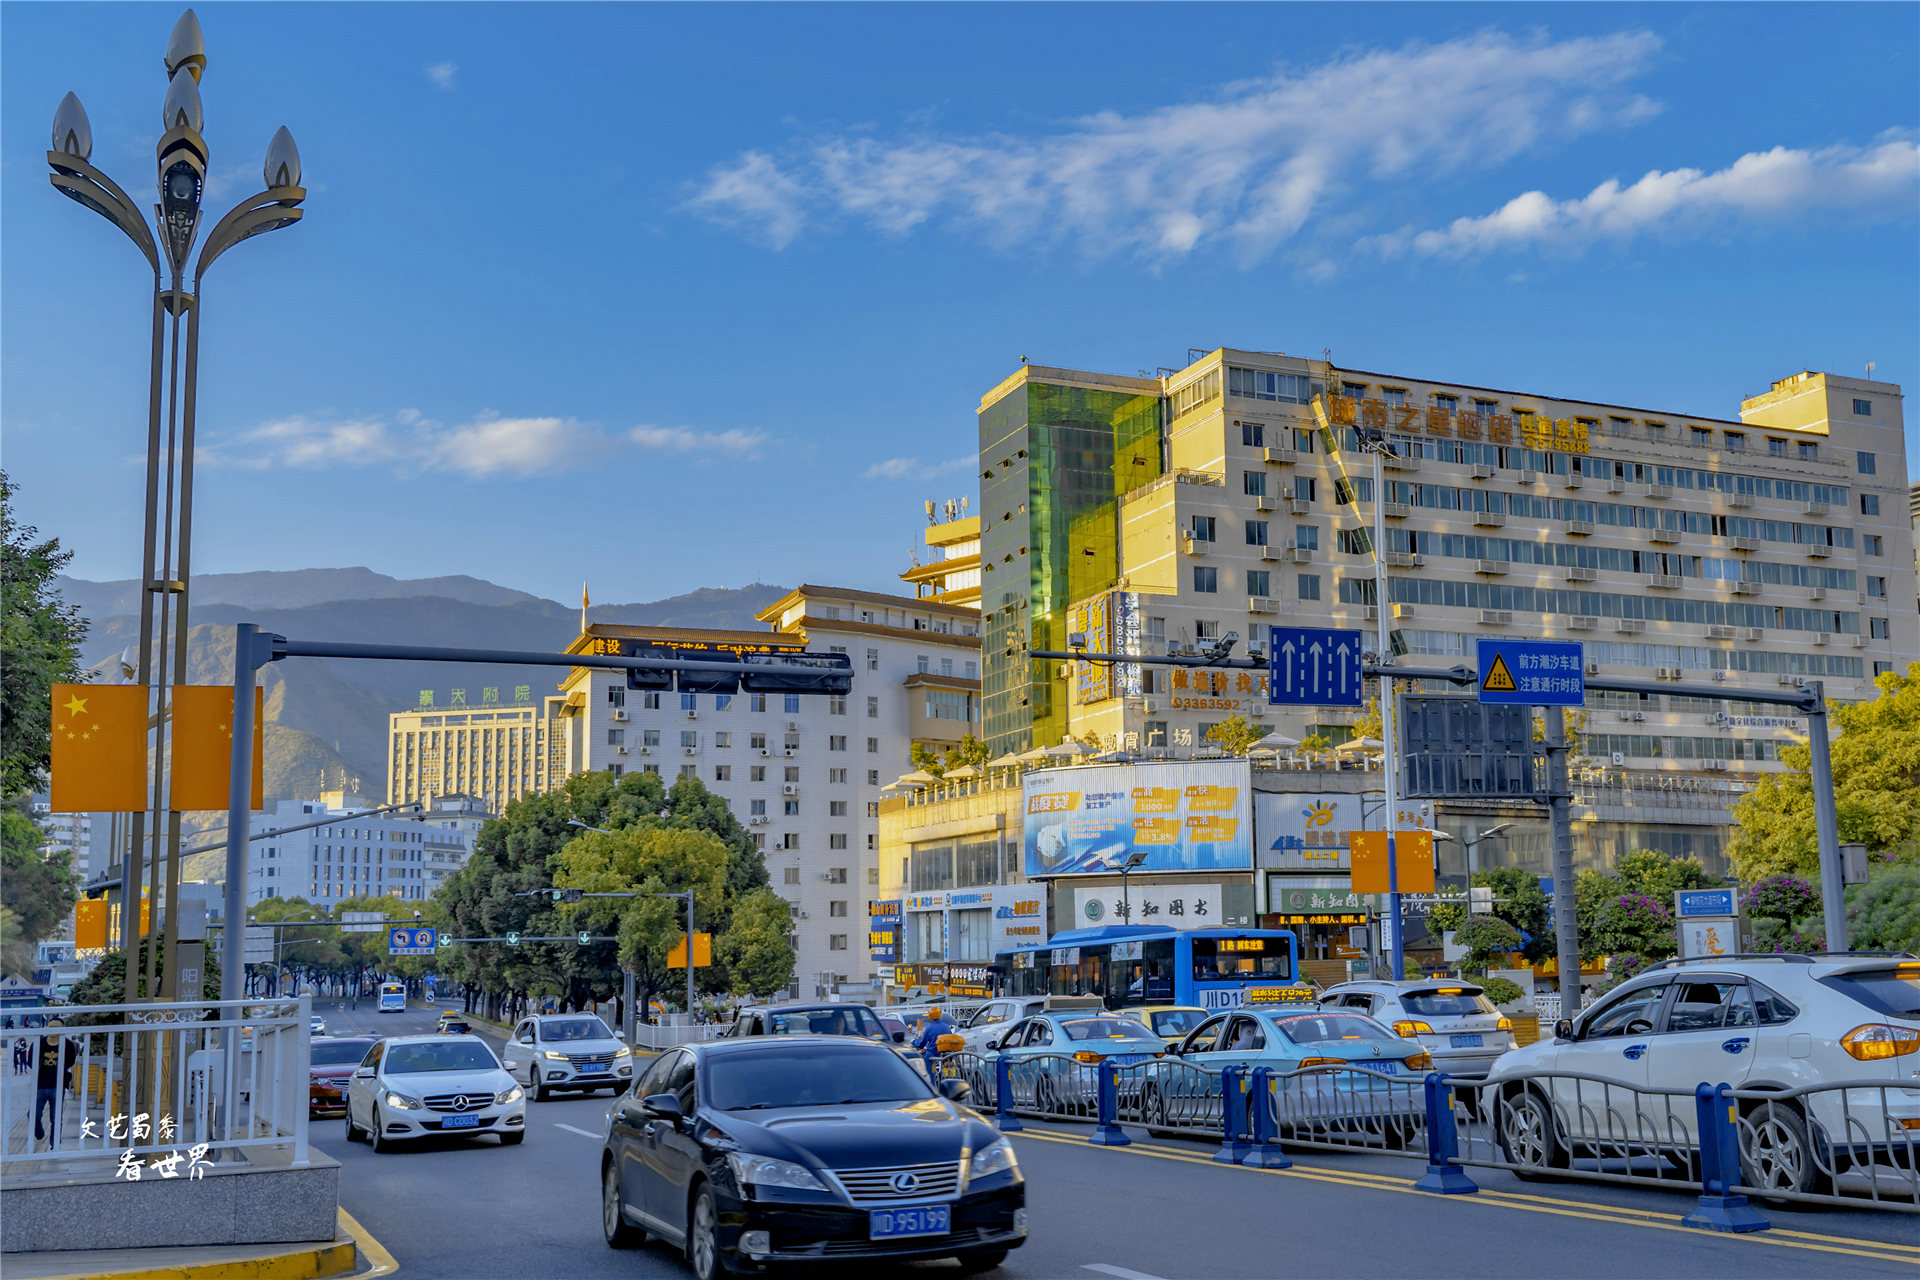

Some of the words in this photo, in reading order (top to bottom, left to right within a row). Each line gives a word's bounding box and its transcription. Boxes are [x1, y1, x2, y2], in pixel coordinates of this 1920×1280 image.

[1329, 395, 1512, 442] 城市之星酒店
[1520, 414, 1589, 440] 住宿茶楼
[1538, 437, 1590, 453] 5795888
[595, 639, 620, 653] 建设
[1519, 654, 1580, 670] 前方潮汐车道
[1520, 677, 1580, 693] 注意通行时段
[419, 685, 530, 706] 攀大附院
[1183, 698, 1239, 710] 3363592
[1304, 851, 1338, 860] 请上二楼
[1114, 899, 1208, 917] 新知图书
[1227, 916, 1249, 925] 二楼
